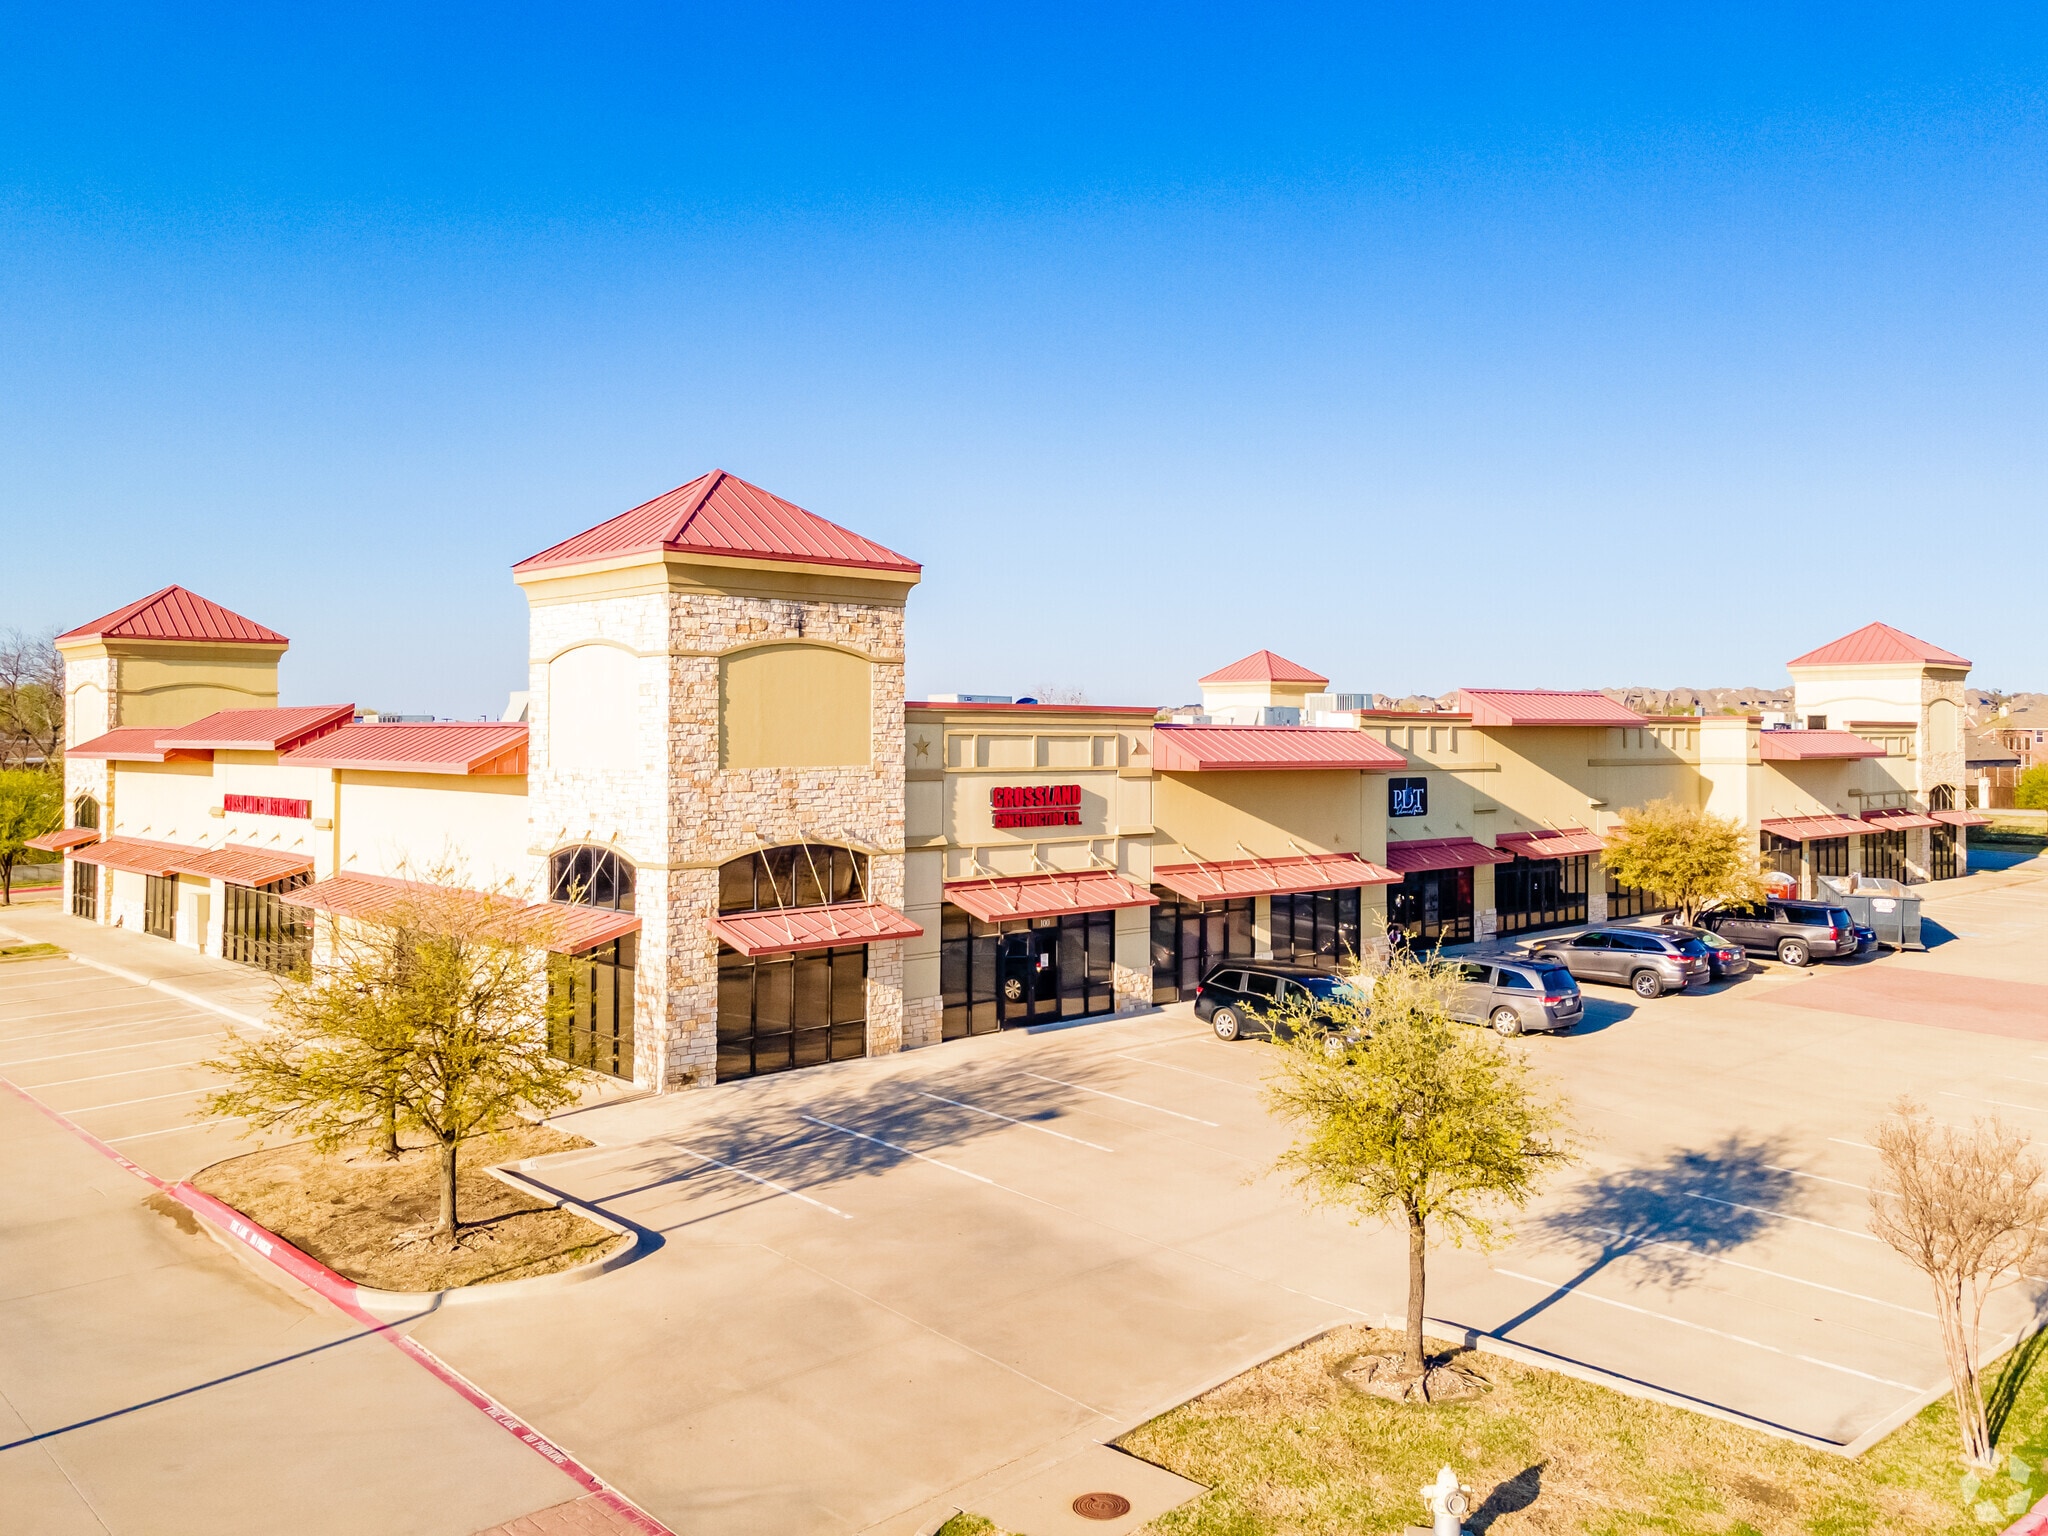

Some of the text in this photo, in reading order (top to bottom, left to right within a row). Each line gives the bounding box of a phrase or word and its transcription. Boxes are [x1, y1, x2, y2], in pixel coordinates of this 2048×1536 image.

[993, 785, 1081, 808] CROSSLAND
[993, 811, 1064, 828] CONSTRUCTION
[521, 1433, 538, 1442] NO
[532, 1440, 568, 1464] PARKING
